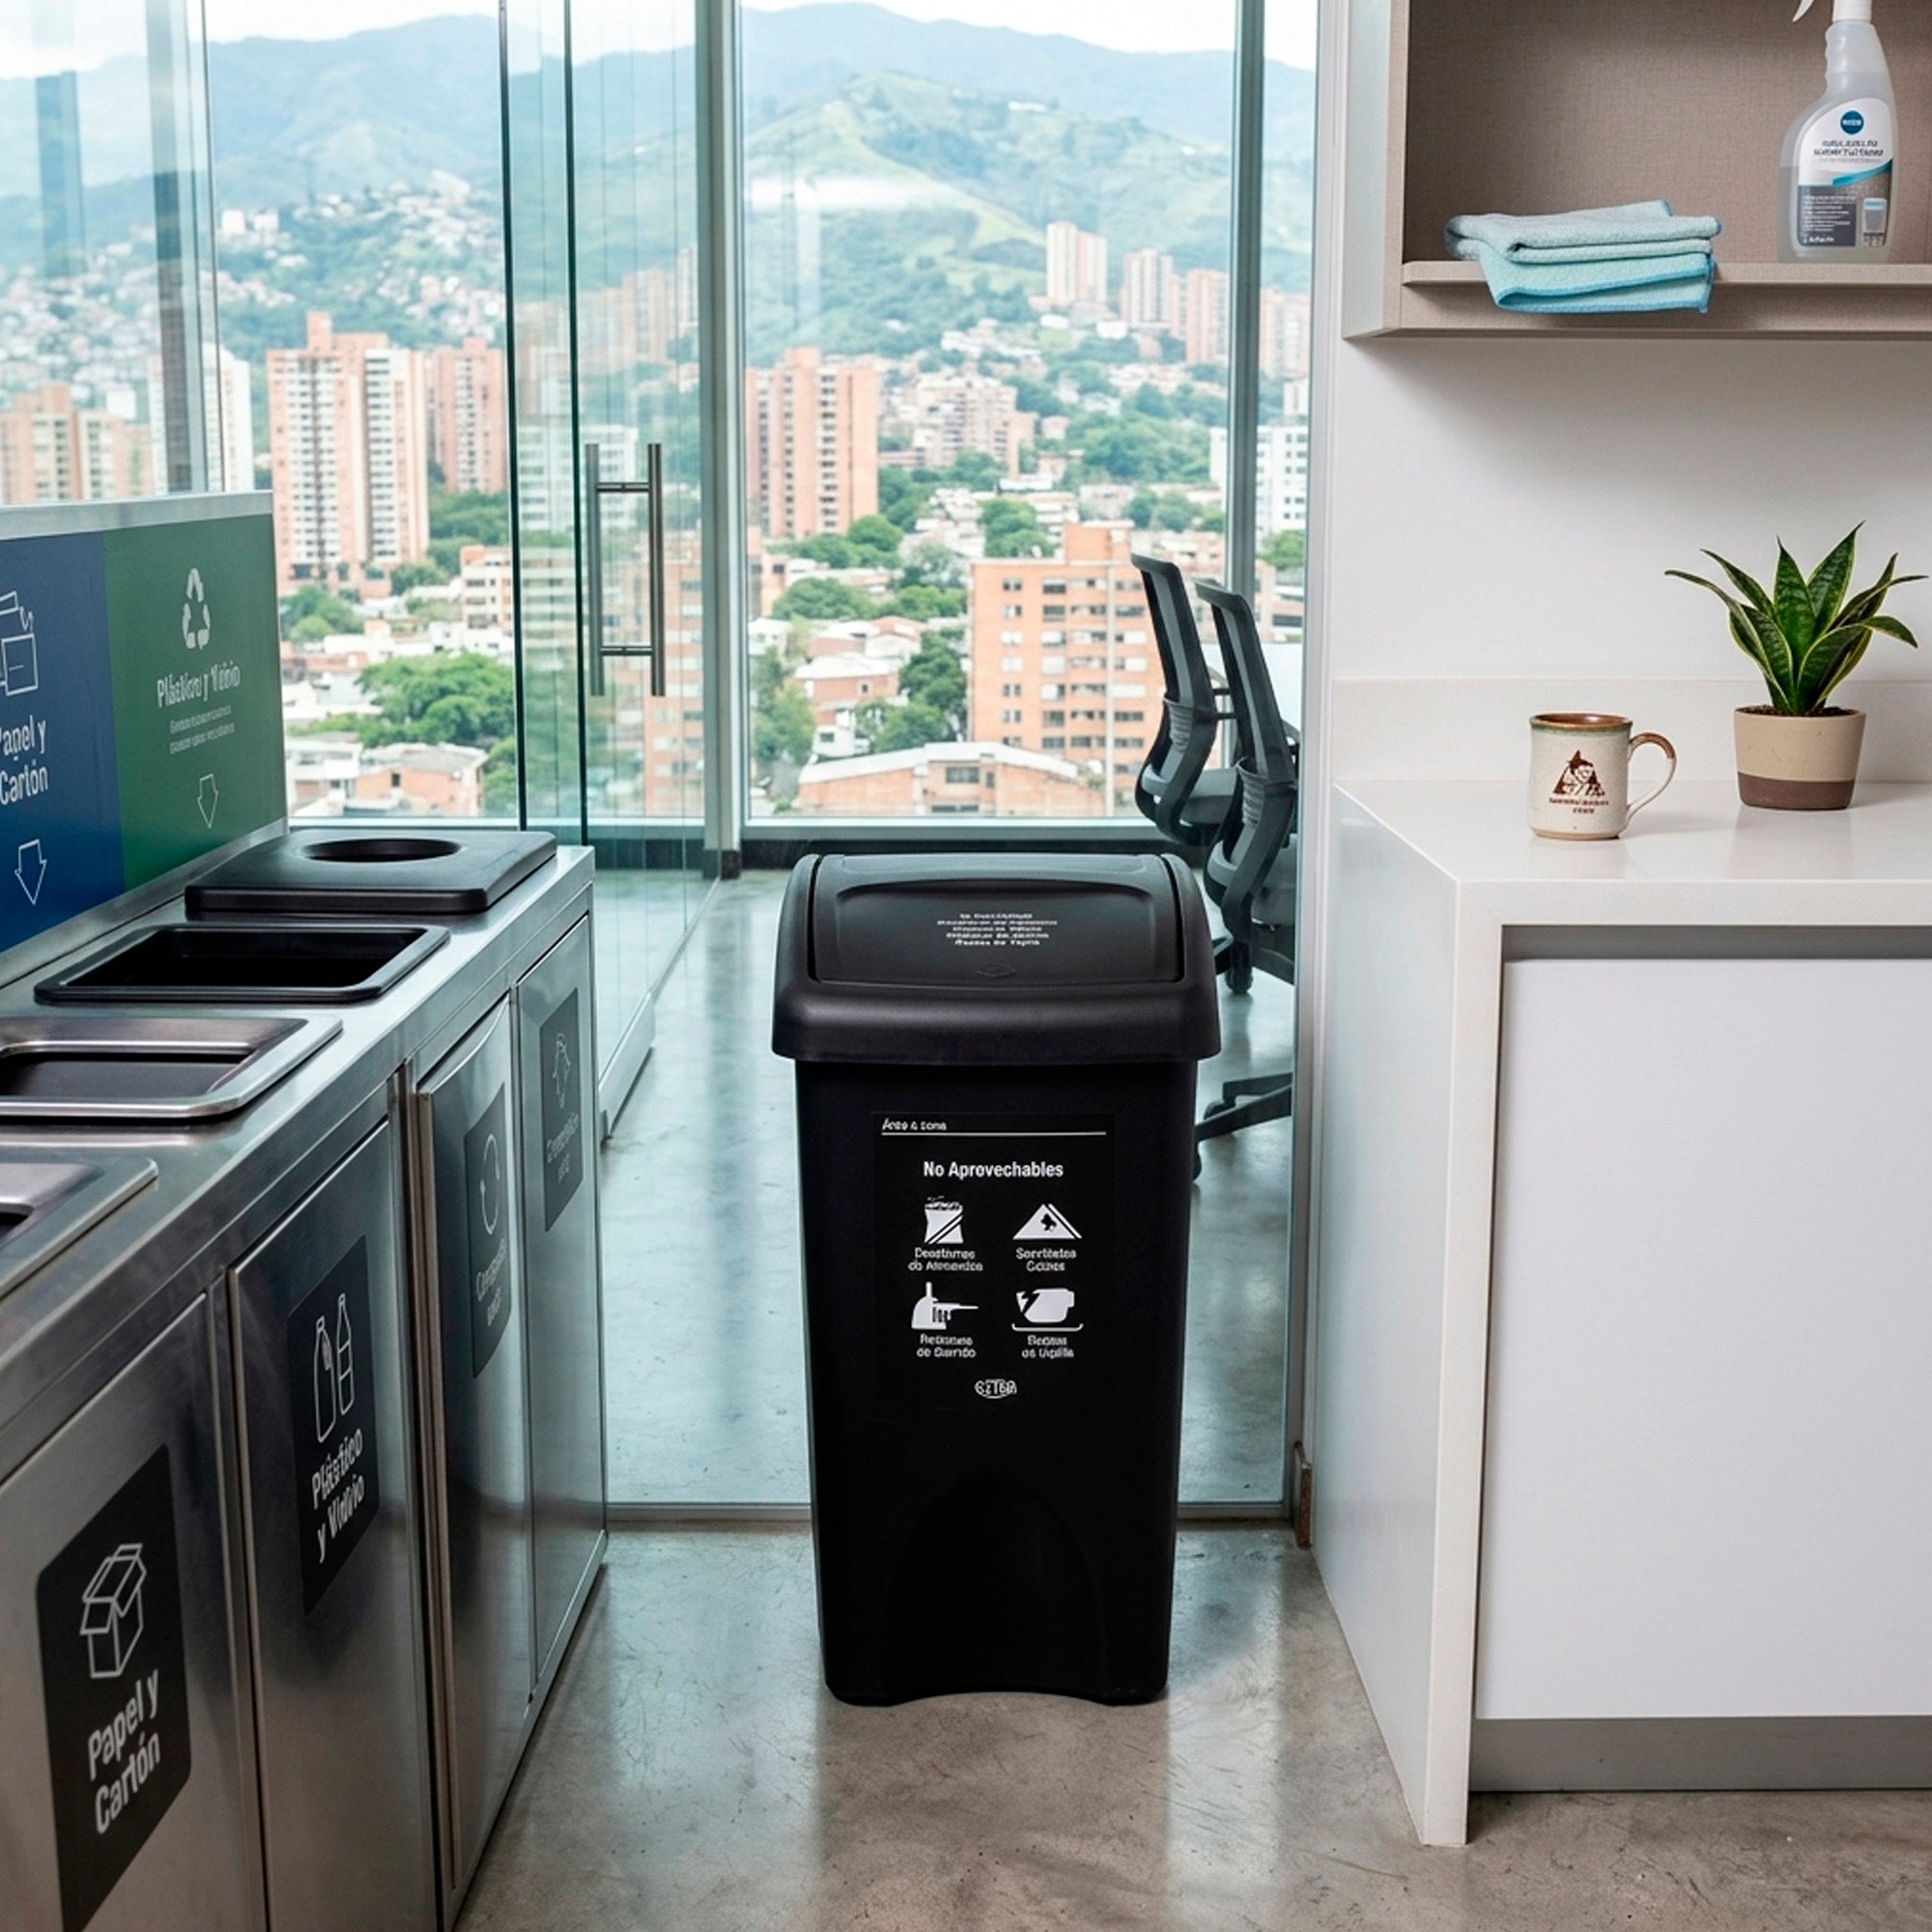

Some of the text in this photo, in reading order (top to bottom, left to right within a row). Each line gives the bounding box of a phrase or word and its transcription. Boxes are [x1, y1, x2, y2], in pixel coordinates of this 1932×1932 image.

[37, 720, 47, 754] y
[923, 1160, 1065, 1181] No Aprovechables
[317, 1522, 327, 1564] y
[88, 1667, 159, 1781] Papel y
[95, 1730, 161, 1834] Cartón
